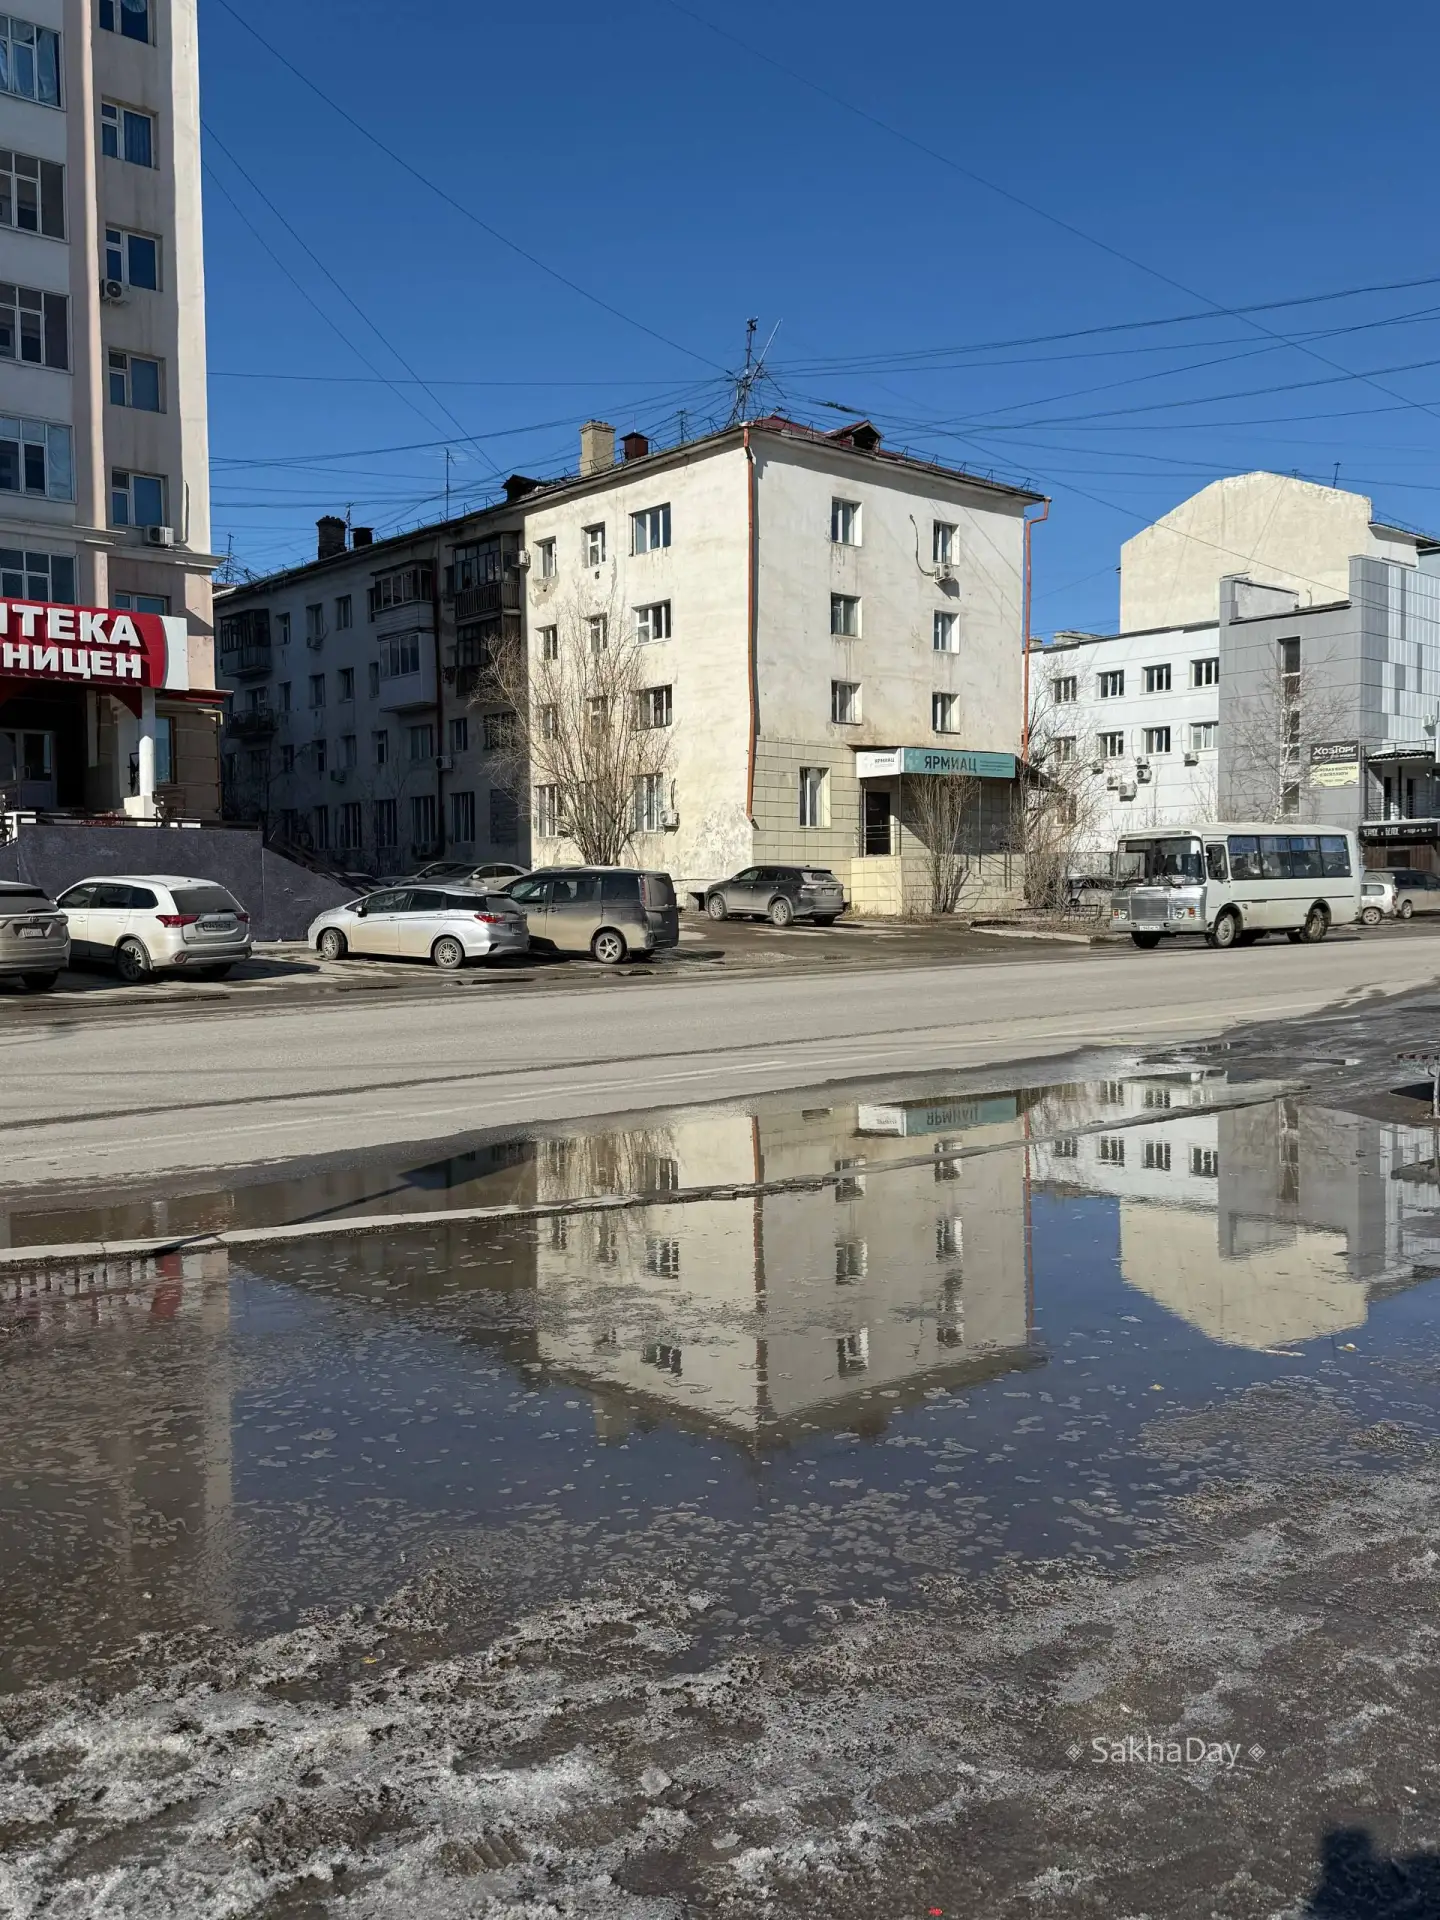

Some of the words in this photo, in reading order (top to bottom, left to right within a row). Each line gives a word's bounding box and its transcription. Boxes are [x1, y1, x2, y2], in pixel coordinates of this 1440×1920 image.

[0, 602, 141, 647] ТЕКА
[3, 642, 142, 680] НИЦЕН
[924, 755, 977, 774] ЯРМИАЦ
